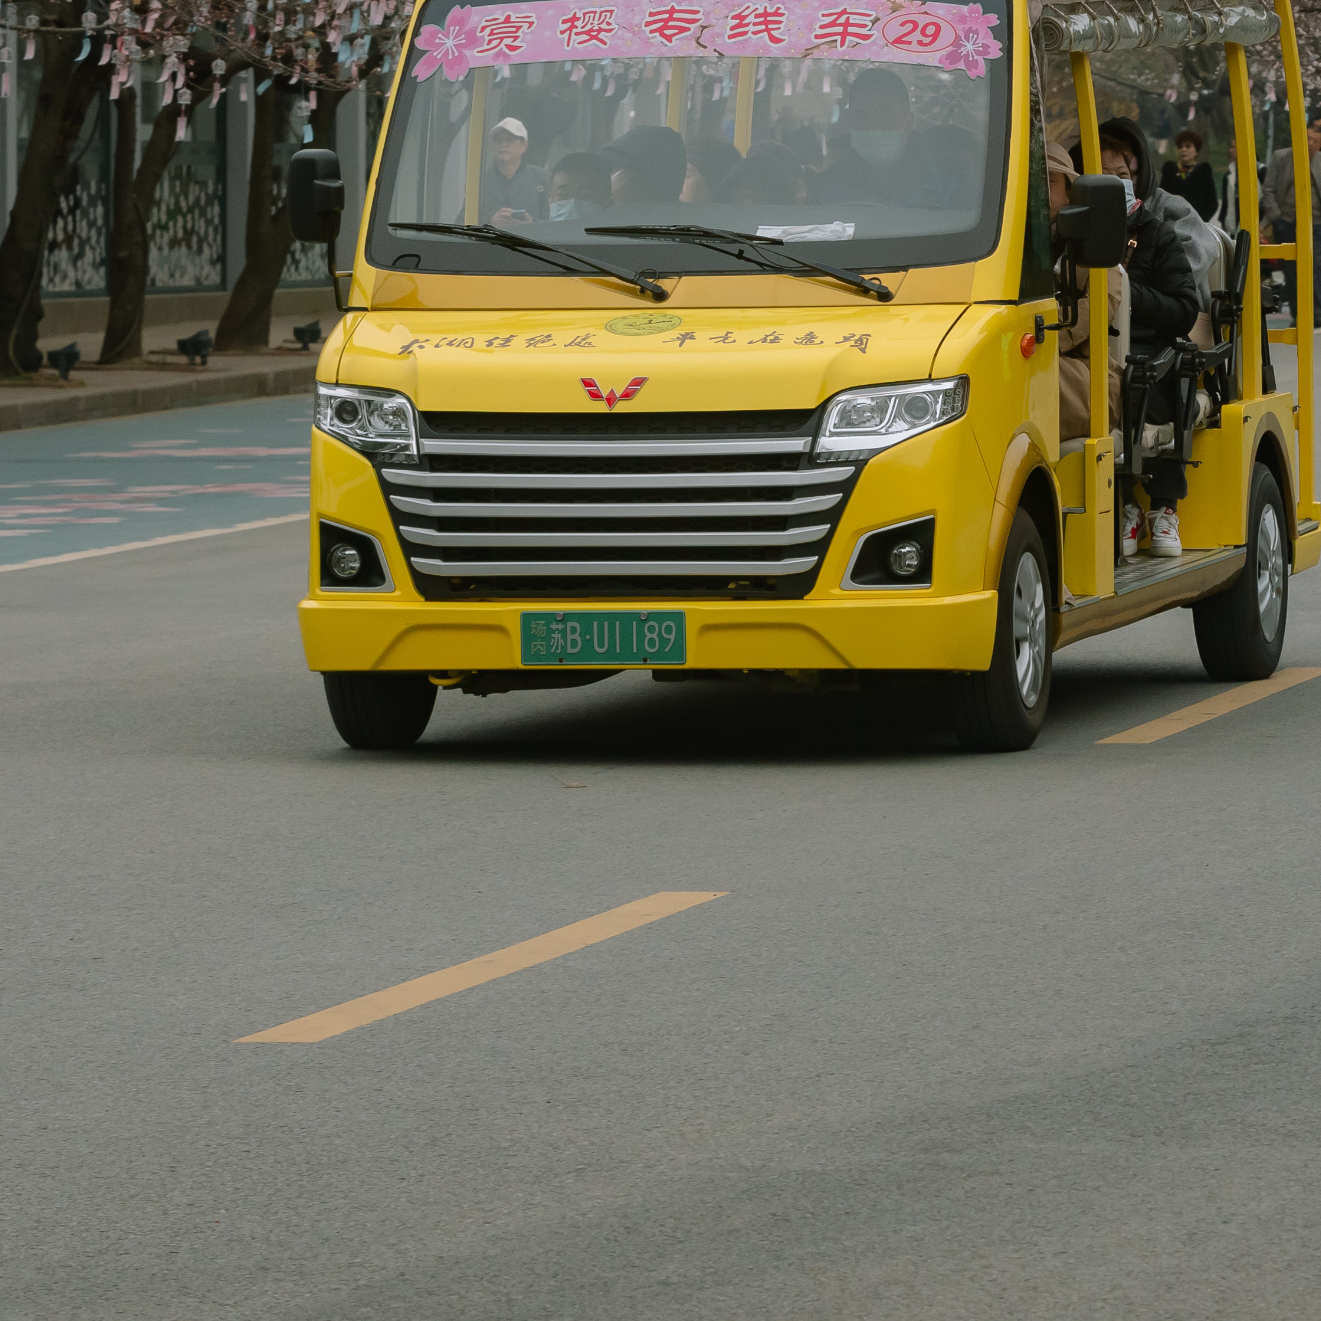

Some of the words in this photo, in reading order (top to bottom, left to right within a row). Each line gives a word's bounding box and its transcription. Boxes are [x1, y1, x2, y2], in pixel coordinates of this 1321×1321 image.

[478, 5, 875, 55] 赏樱专线车
[897, 18, 941, 46] 29
[530, 620, 547, 655] 场内
